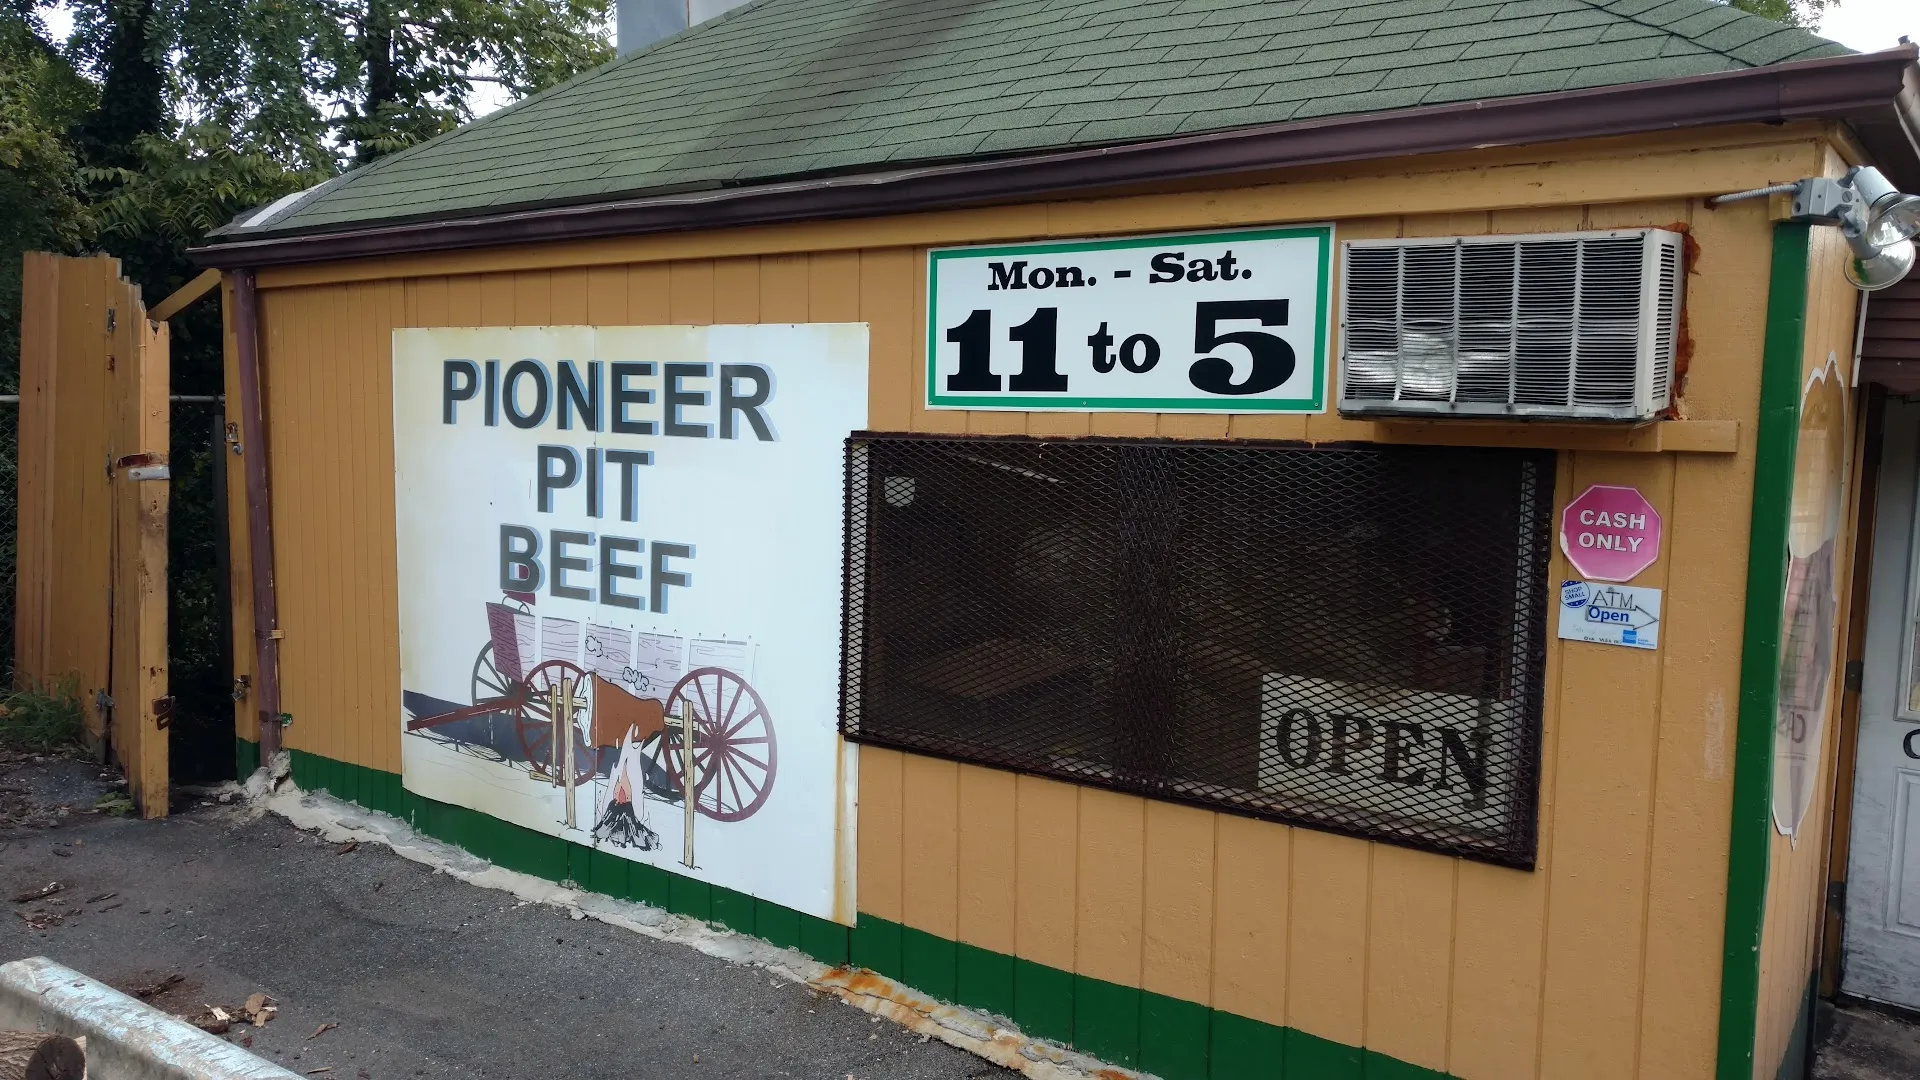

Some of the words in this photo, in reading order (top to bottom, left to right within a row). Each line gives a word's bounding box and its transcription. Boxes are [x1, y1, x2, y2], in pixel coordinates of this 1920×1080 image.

[988, 260, 1097, 290] Mon.
[1149, 250, 1253, 284] Sat.
[946, 307, 1069, 392] 11
[1087, 321, 1161, 374] to
[1188, 298, 1296, 396] 5
[443, 358, 781, 442] PIONEER
[537, 443, 655, 523] PIT
[1579, 509, 1646, 530] CASH
[1578, 532, 1644, 553] ONLY
[499, 523, 697, 615] BEEF
[1564, 592, 1586, 601] SMALL
[1589, 606, 1630, 622] Open
[1592, 589, 1633, 609] ATM
[1276, 707, 1489, 810] OPEN
